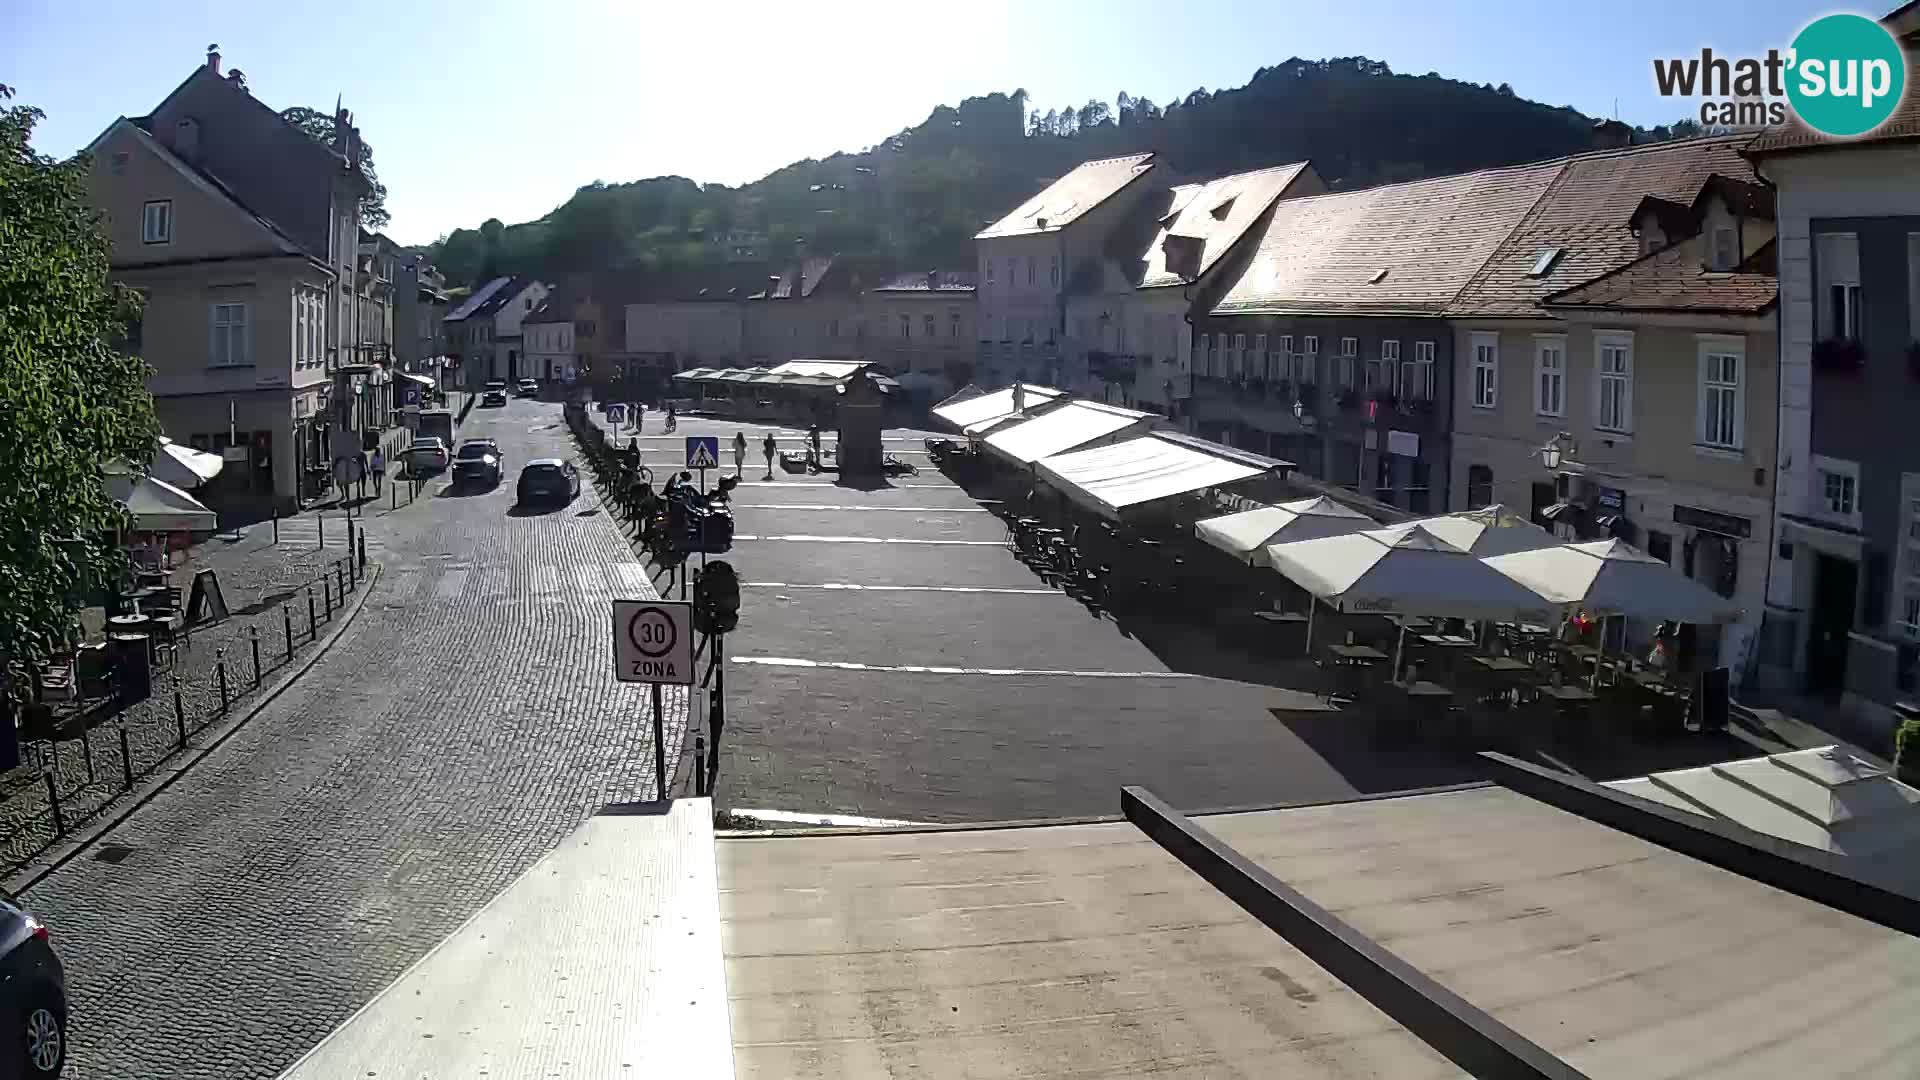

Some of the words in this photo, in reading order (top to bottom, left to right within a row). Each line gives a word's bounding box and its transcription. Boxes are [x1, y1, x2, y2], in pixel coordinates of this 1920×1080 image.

[407, 391, 416, 402] P
[641, 622, 665, 644] 30
[631, 660, 676, 677] ZONA
